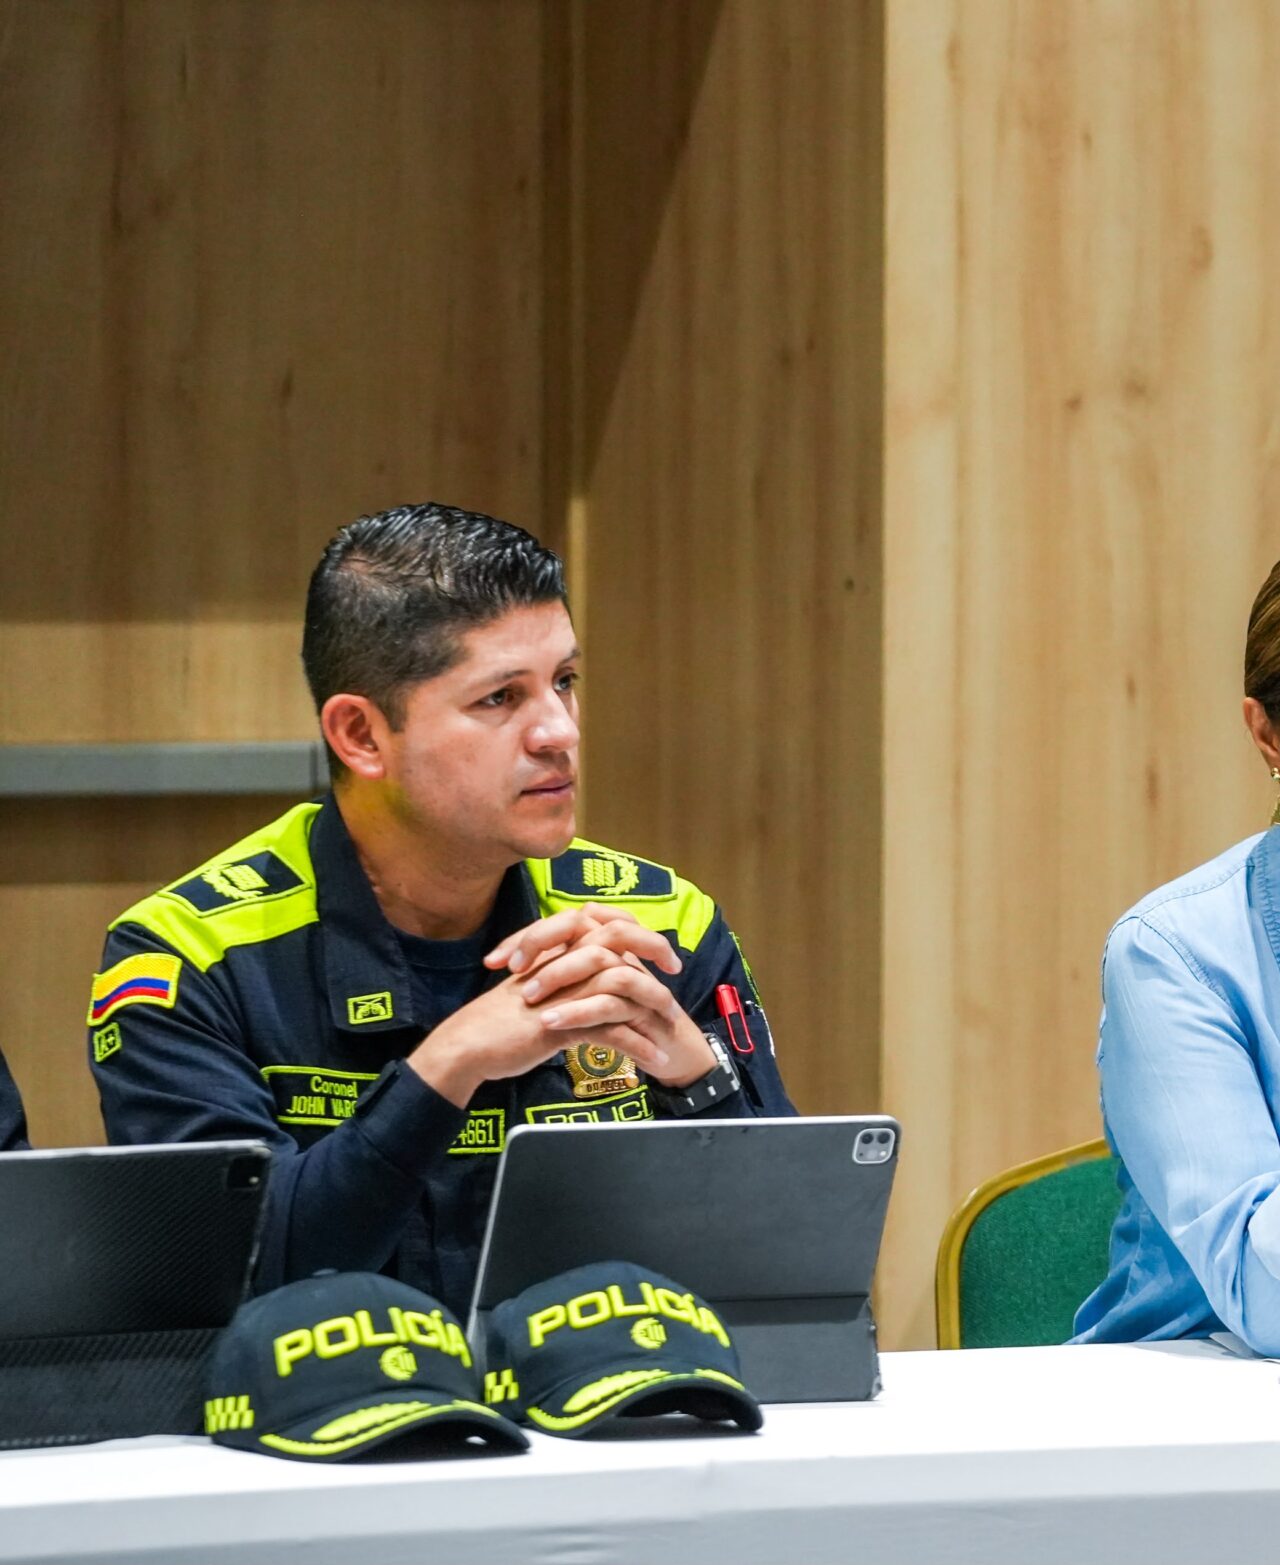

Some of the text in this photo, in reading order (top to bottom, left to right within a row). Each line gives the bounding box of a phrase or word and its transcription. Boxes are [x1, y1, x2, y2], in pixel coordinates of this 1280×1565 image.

[310, 1075, 358, 1098] Coronel
[286, 1095, 326, 1115] JOHN
[451, 1118, 496, 1145] 4661
[527, 1282, 731, 1348] POLICÍA
[273, 1307, 472, 1377] POLICÍA
